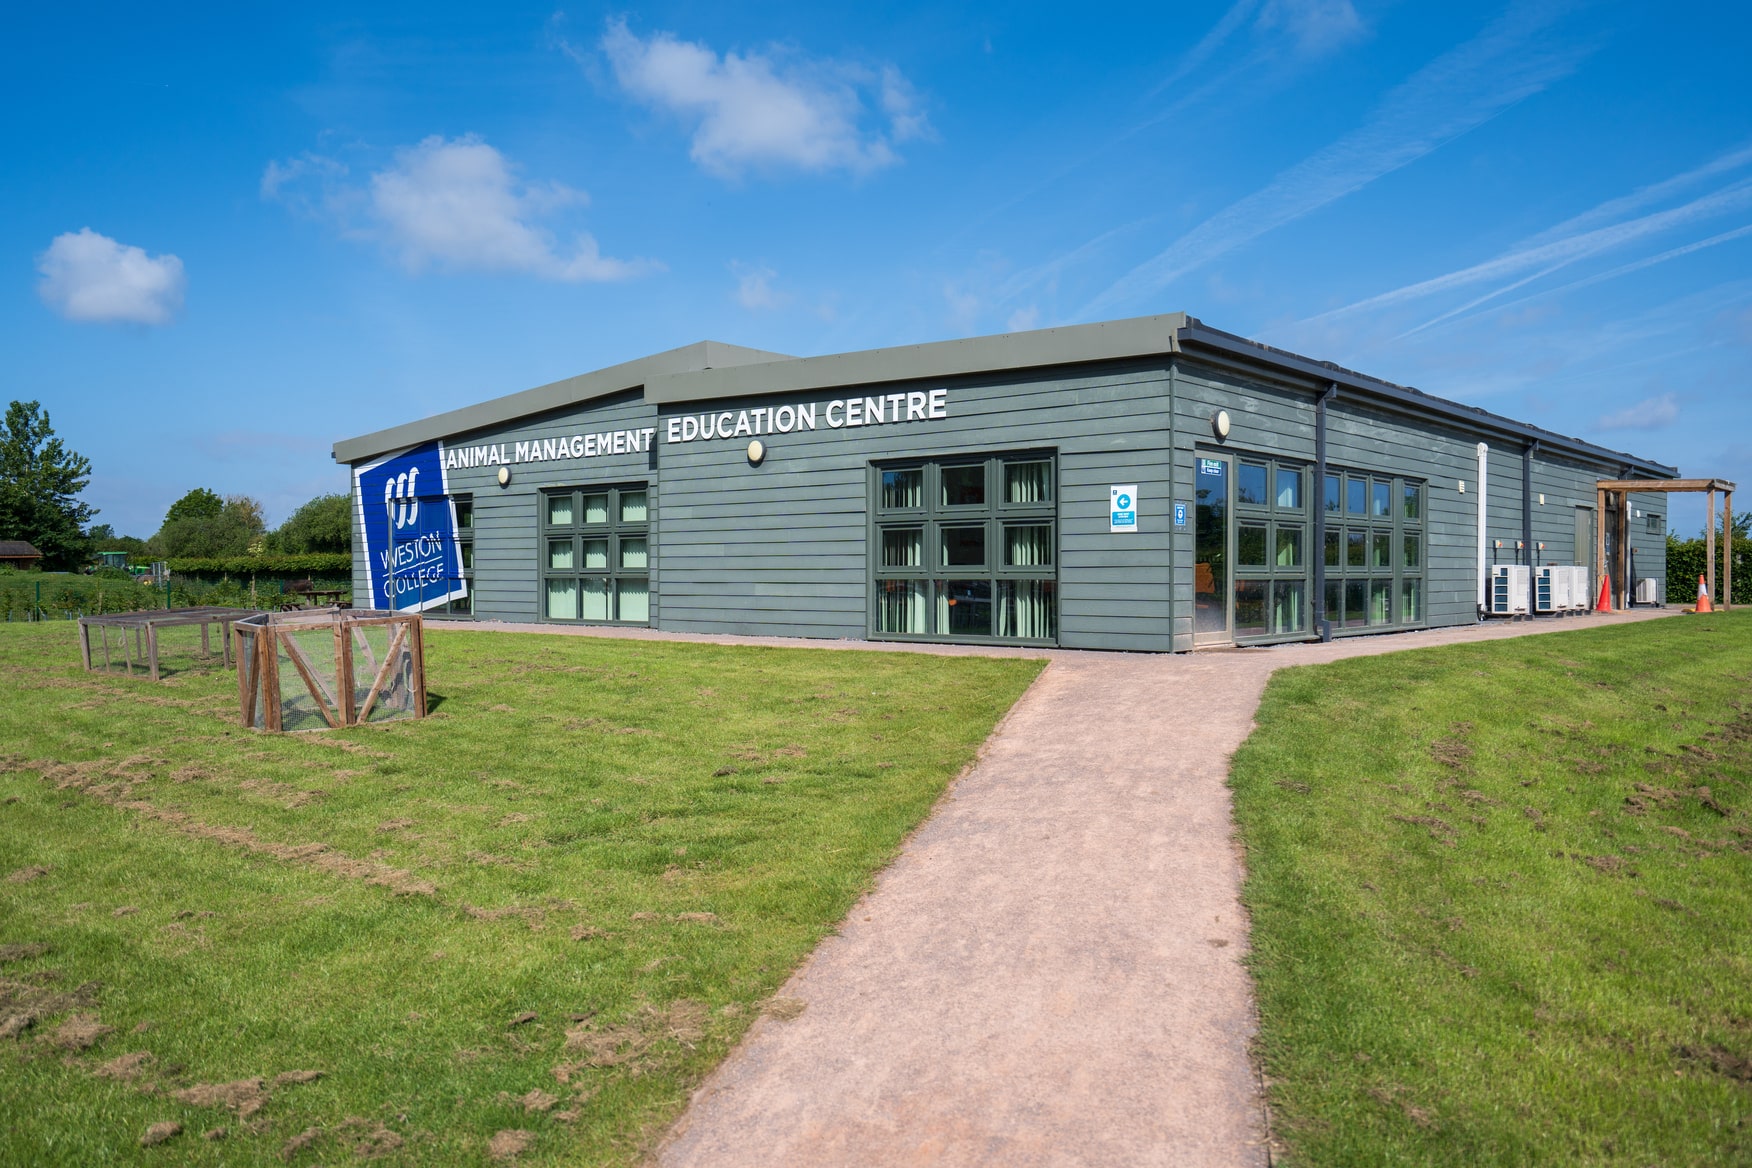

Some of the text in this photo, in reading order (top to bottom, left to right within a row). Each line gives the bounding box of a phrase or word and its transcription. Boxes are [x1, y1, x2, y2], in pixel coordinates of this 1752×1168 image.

[446, 389, 948, 469] ANIMAL MANAGEMENT EDUCATION CENTRE
[380, 531, 442, 569] WESTON
[383, 563, 444, 598] COLLEGE
